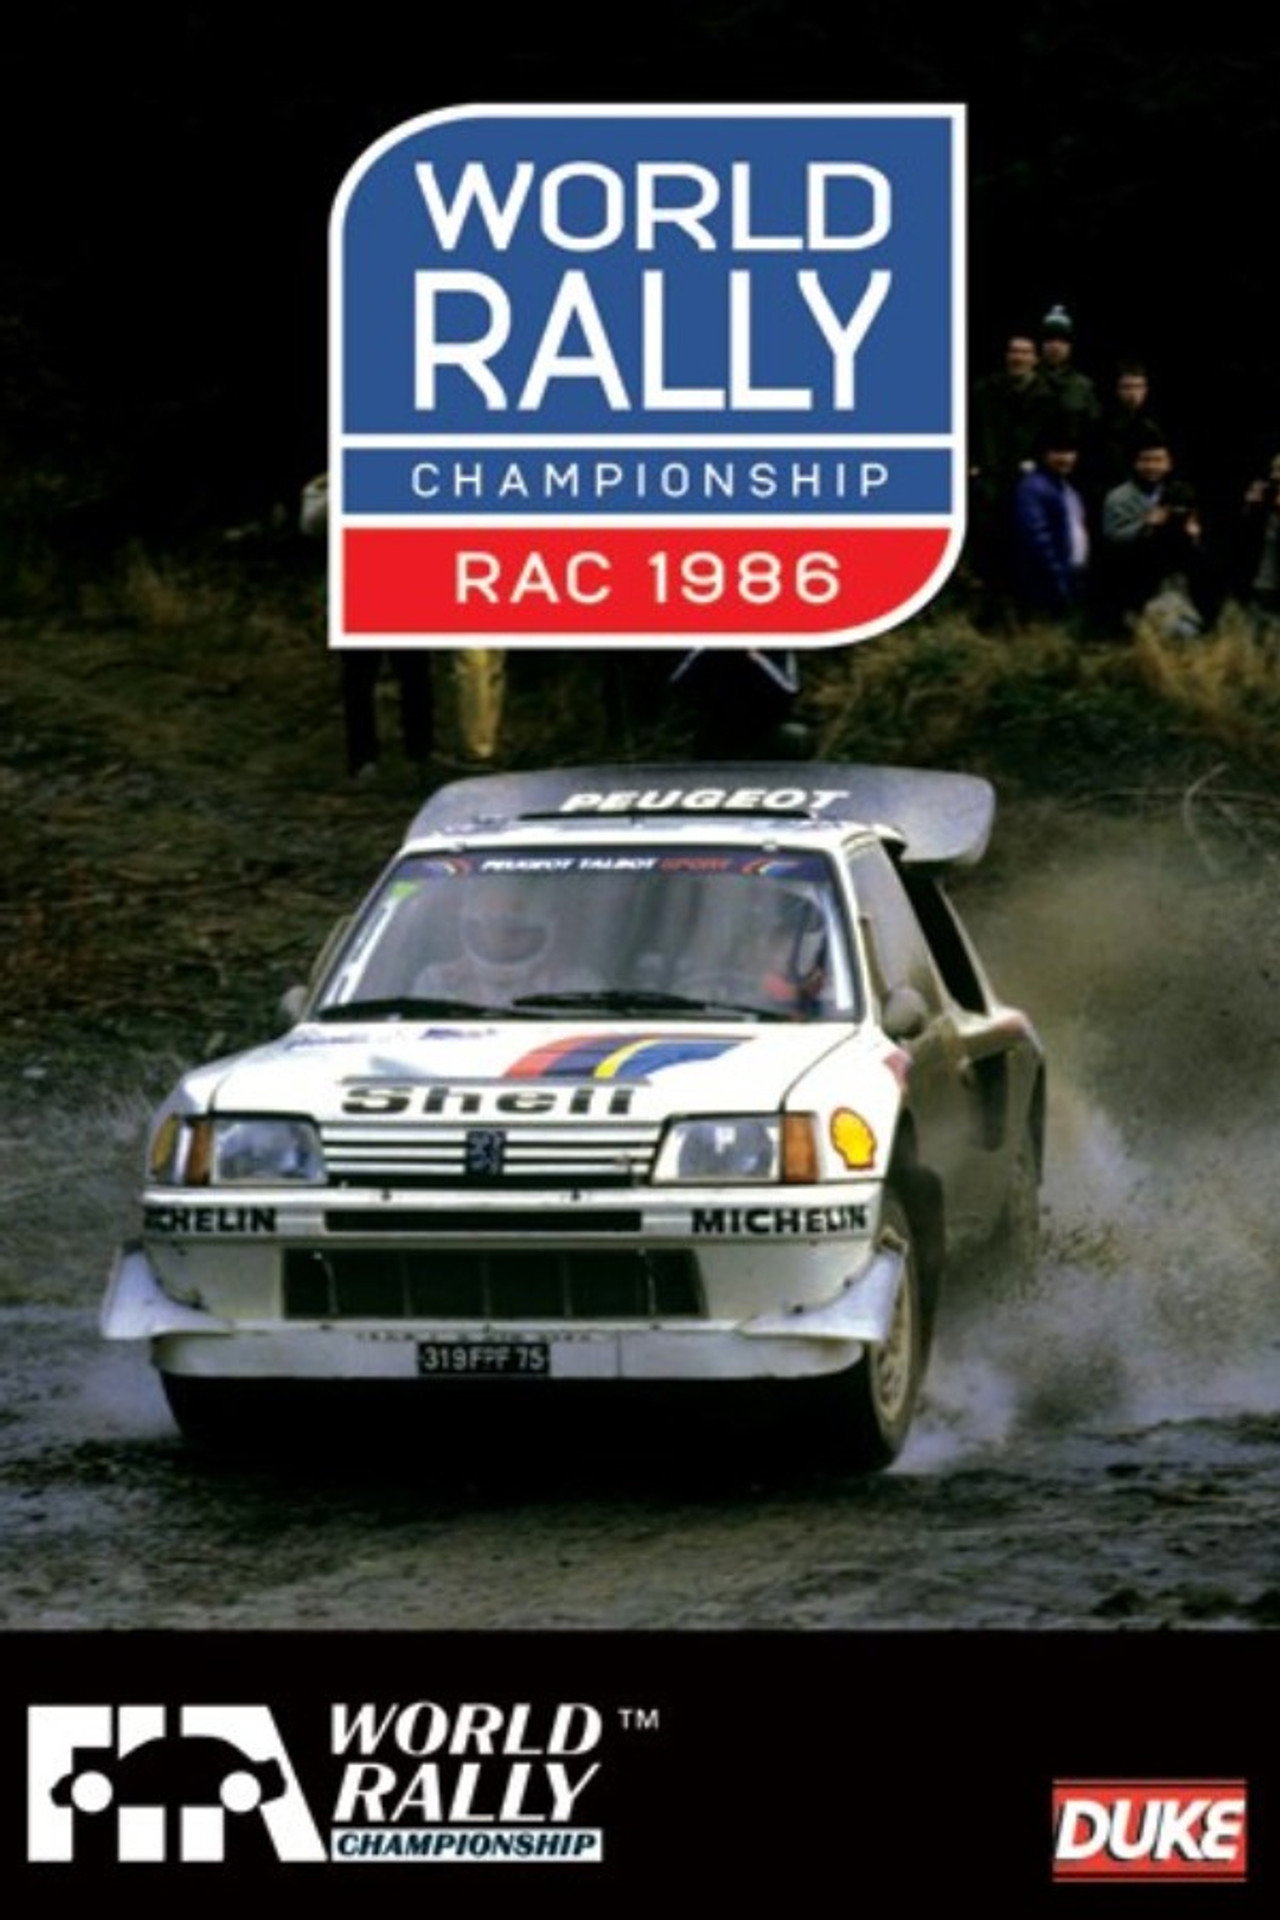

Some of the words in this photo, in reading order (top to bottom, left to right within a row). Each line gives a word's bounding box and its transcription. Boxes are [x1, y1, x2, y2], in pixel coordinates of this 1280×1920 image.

[559, 788, 850, 813] PEUGEOT
[481, 857, 572, 871] PEUGEOT
[578, 857, 657, 870] TALBOT
[341, 1085, 634, 1115] Shell
[690, 1206, 867, 1234] MICHELIN
